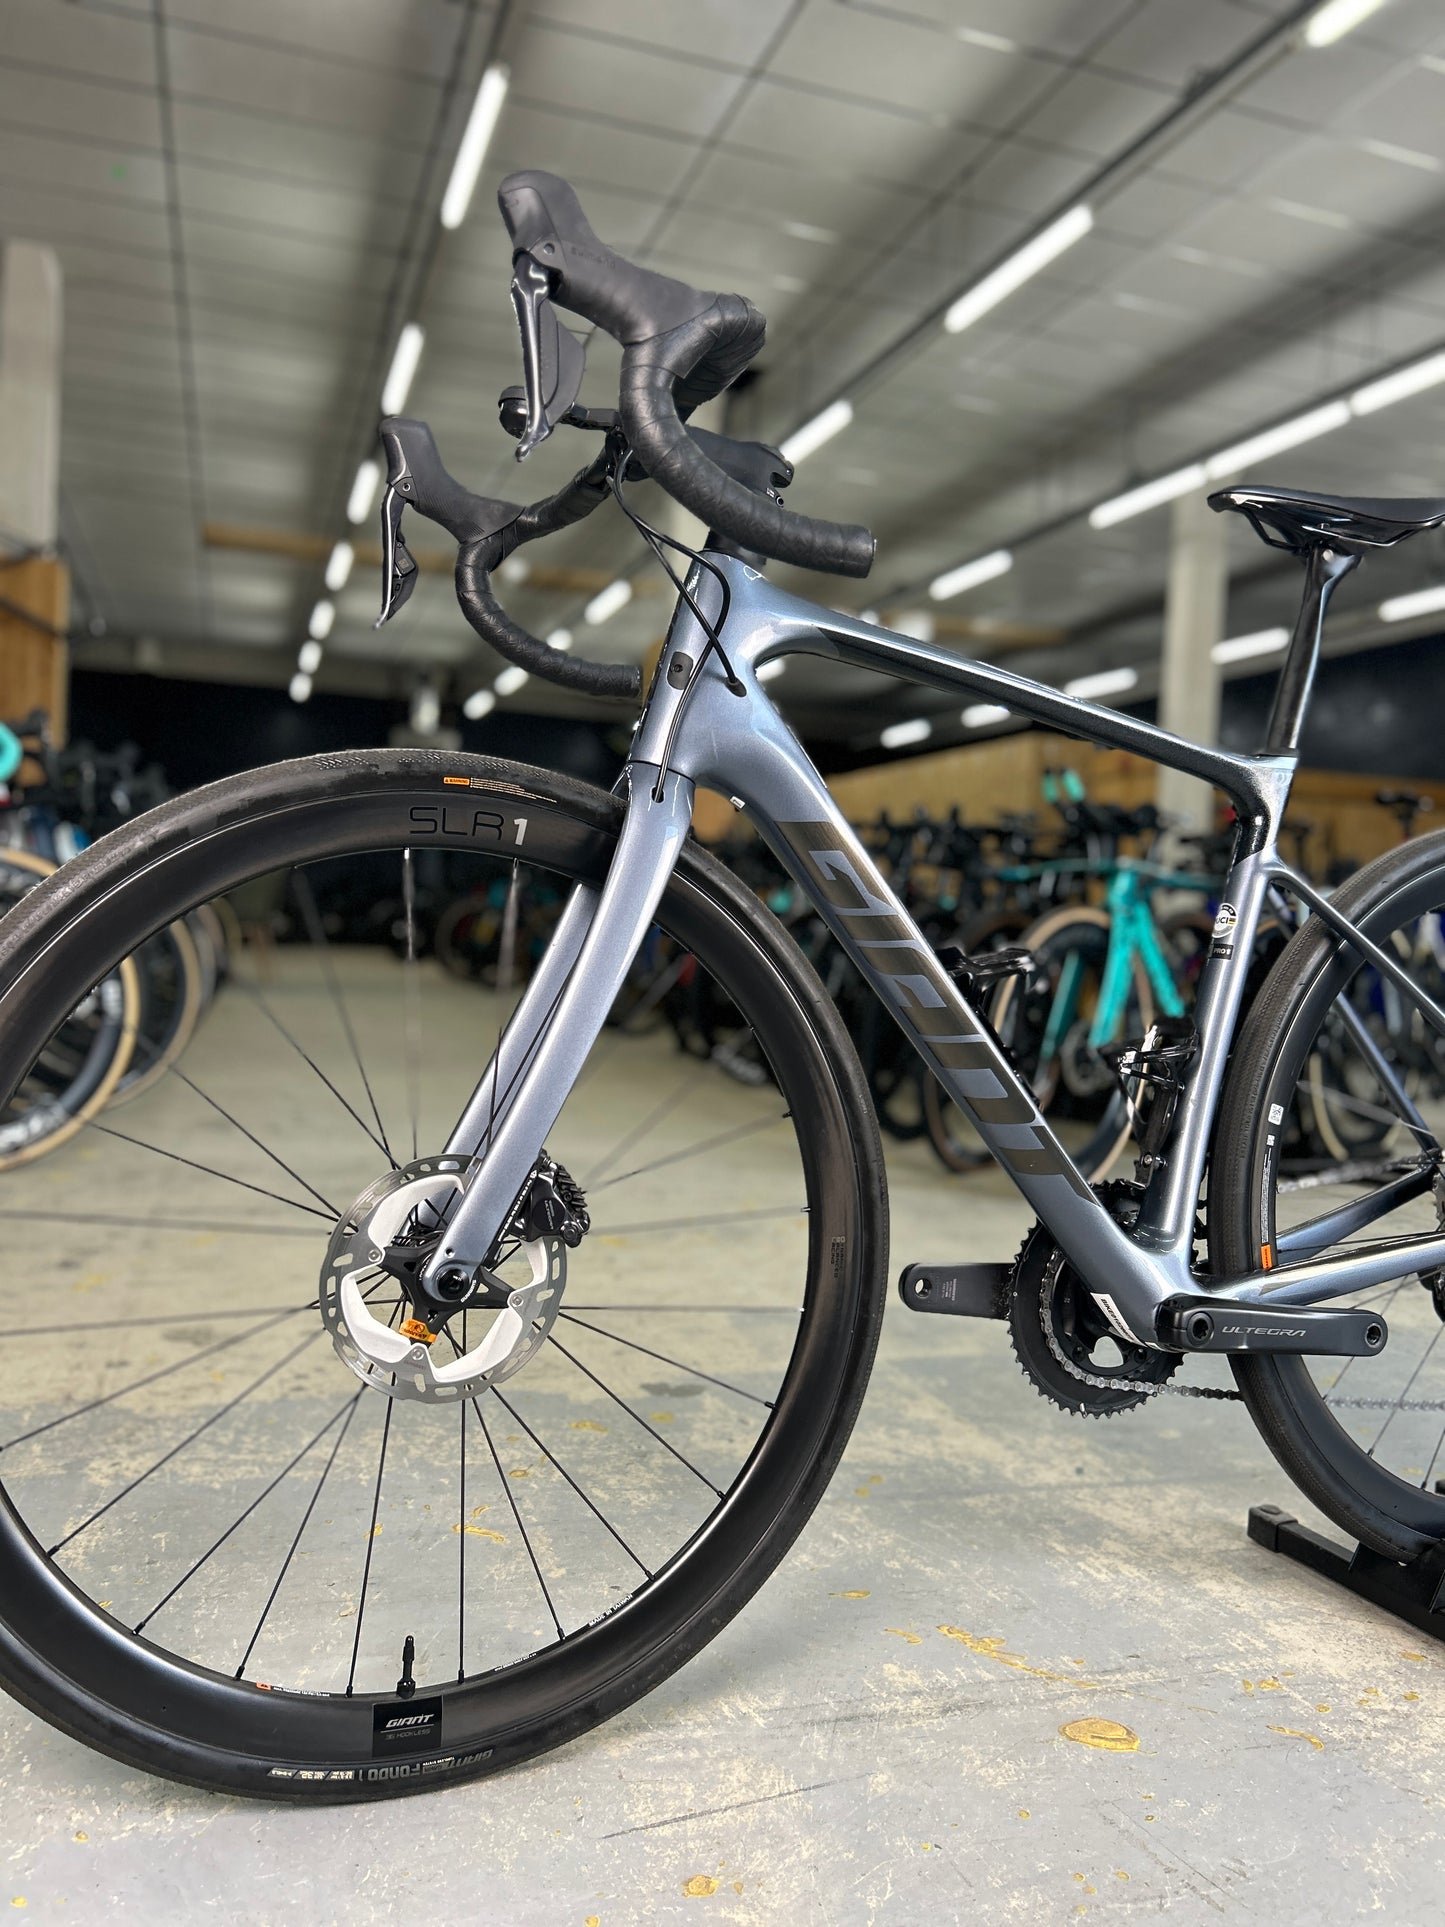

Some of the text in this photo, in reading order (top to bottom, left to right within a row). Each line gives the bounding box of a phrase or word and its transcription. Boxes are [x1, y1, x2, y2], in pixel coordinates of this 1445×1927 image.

[409, 807, 528, 846] SLR 1
[774, 820, 1101, 1208] GIANT
[1221, 1325, 1307, 1337] ULTEGRA
[385, 1713, 435, 1729] GIANT
[367, 1763, 421, 1781] FONDO
